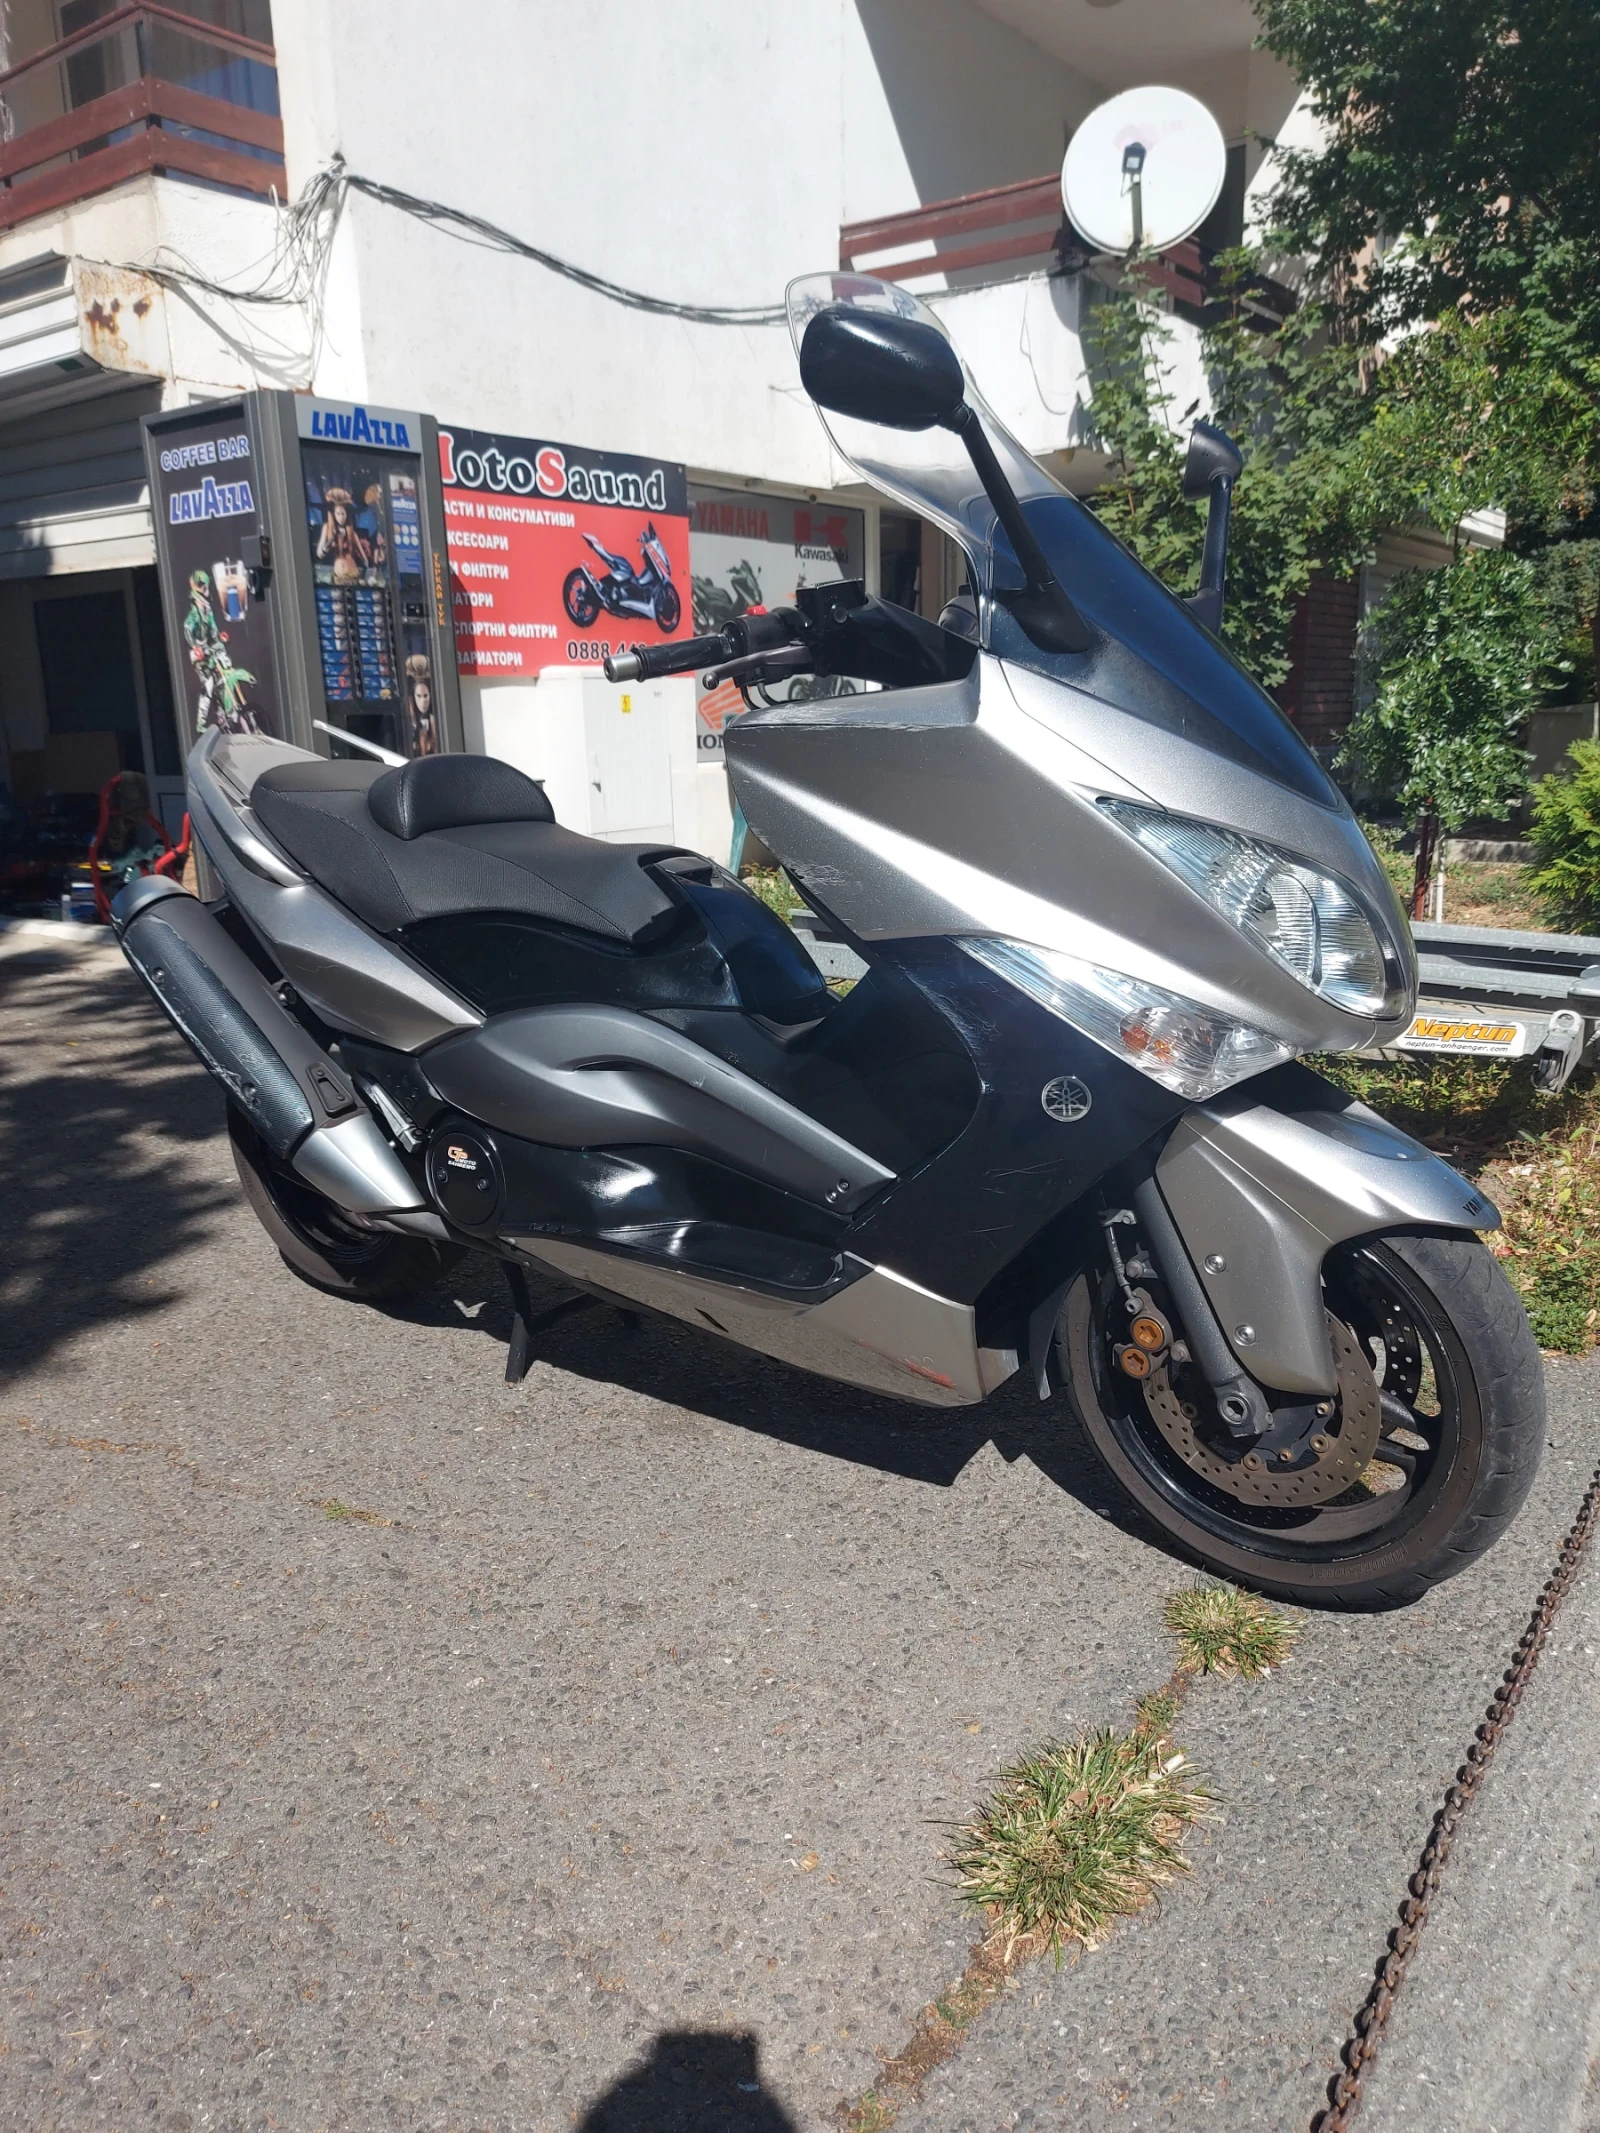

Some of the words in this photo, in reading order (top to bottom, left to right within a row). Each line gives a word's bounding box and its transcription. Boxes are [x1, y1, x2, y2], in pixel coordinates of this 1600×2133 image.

[311, 407, 411, 449] LAVAZZA
[160, 441, 217, 473] COFFEE
[218, 434, 251, 459] BAR
[169, 475, 256, 526] LAVAZZA
[486, 504, 577, 528] КОНСУМАТИВИ
[696, 501, 770, 541] YAMAHA
[794, 543, 849, 564] Kawasaki
[461, 562, 510, 580] ФИЛТРИ
[452, 591, 494, 608] АТОРИ
[508, 623, 558, 639] ФИЛТРИ
[567, 641, 610, 660] 0888
[1406, 1017, 1518, 1043] Neptun
[1405, 1041, 1508, 1052] neptun-anhaenger.com
